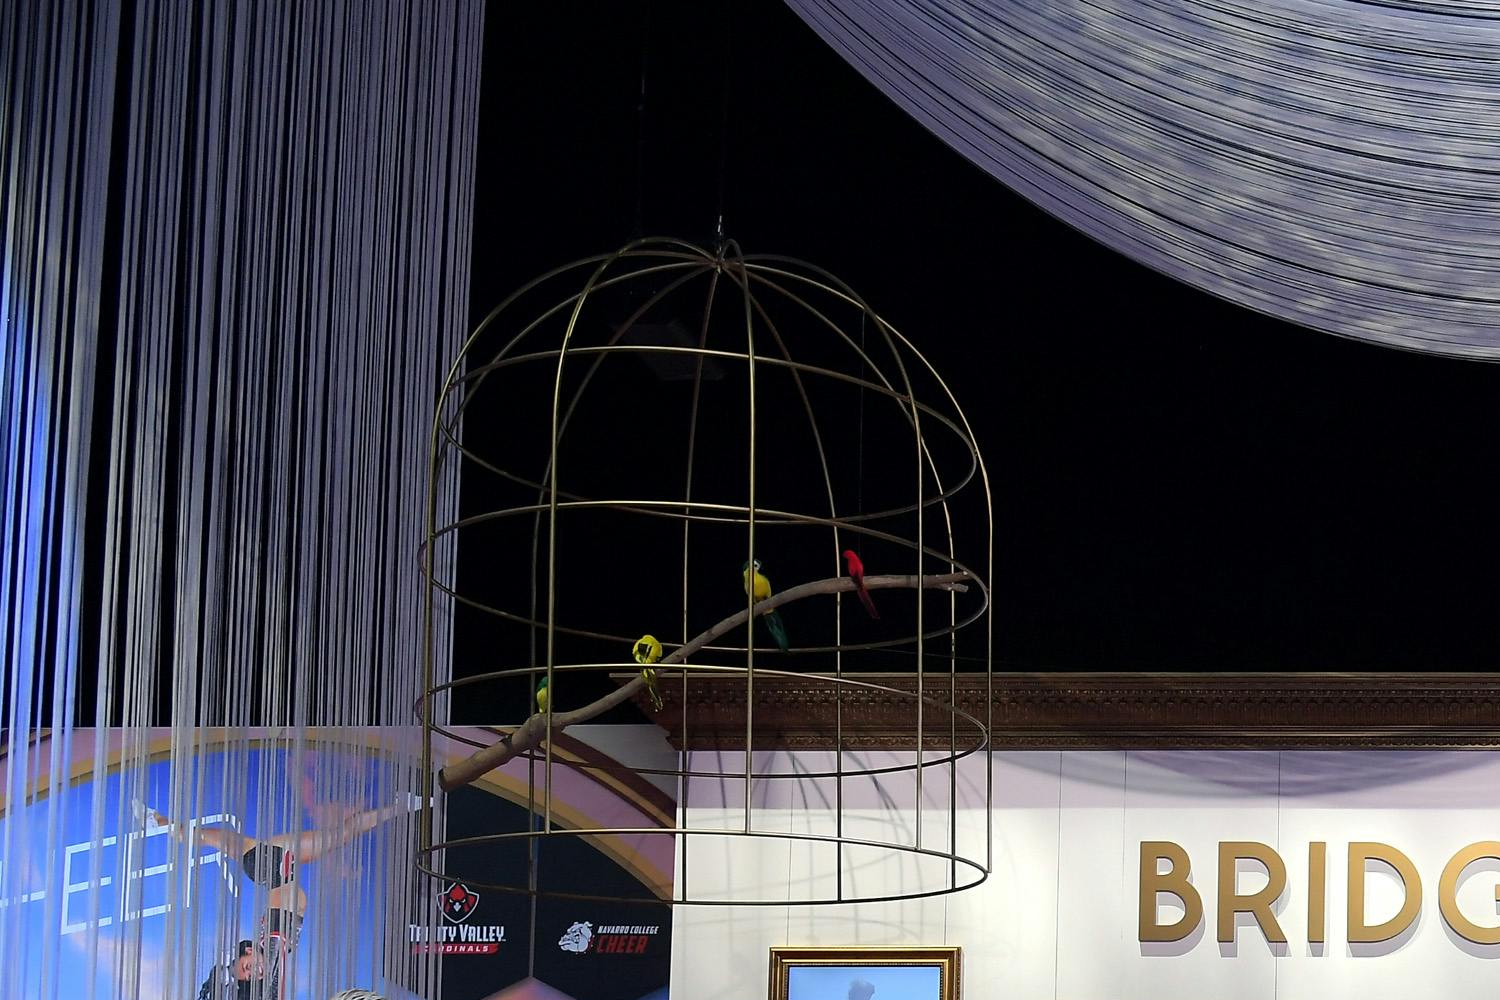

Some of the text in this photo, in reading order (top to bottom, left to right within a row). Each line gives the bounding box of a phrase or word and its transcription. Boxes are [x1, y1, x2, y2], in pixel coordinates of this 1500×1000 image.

[409, 924, 505, 942] TRIITY VALLEY
[630, 926, 660, 935] COLLEGE
[424, 945, 489, 953] CRDINALS
[597, 935, 650, 953] CHEER
